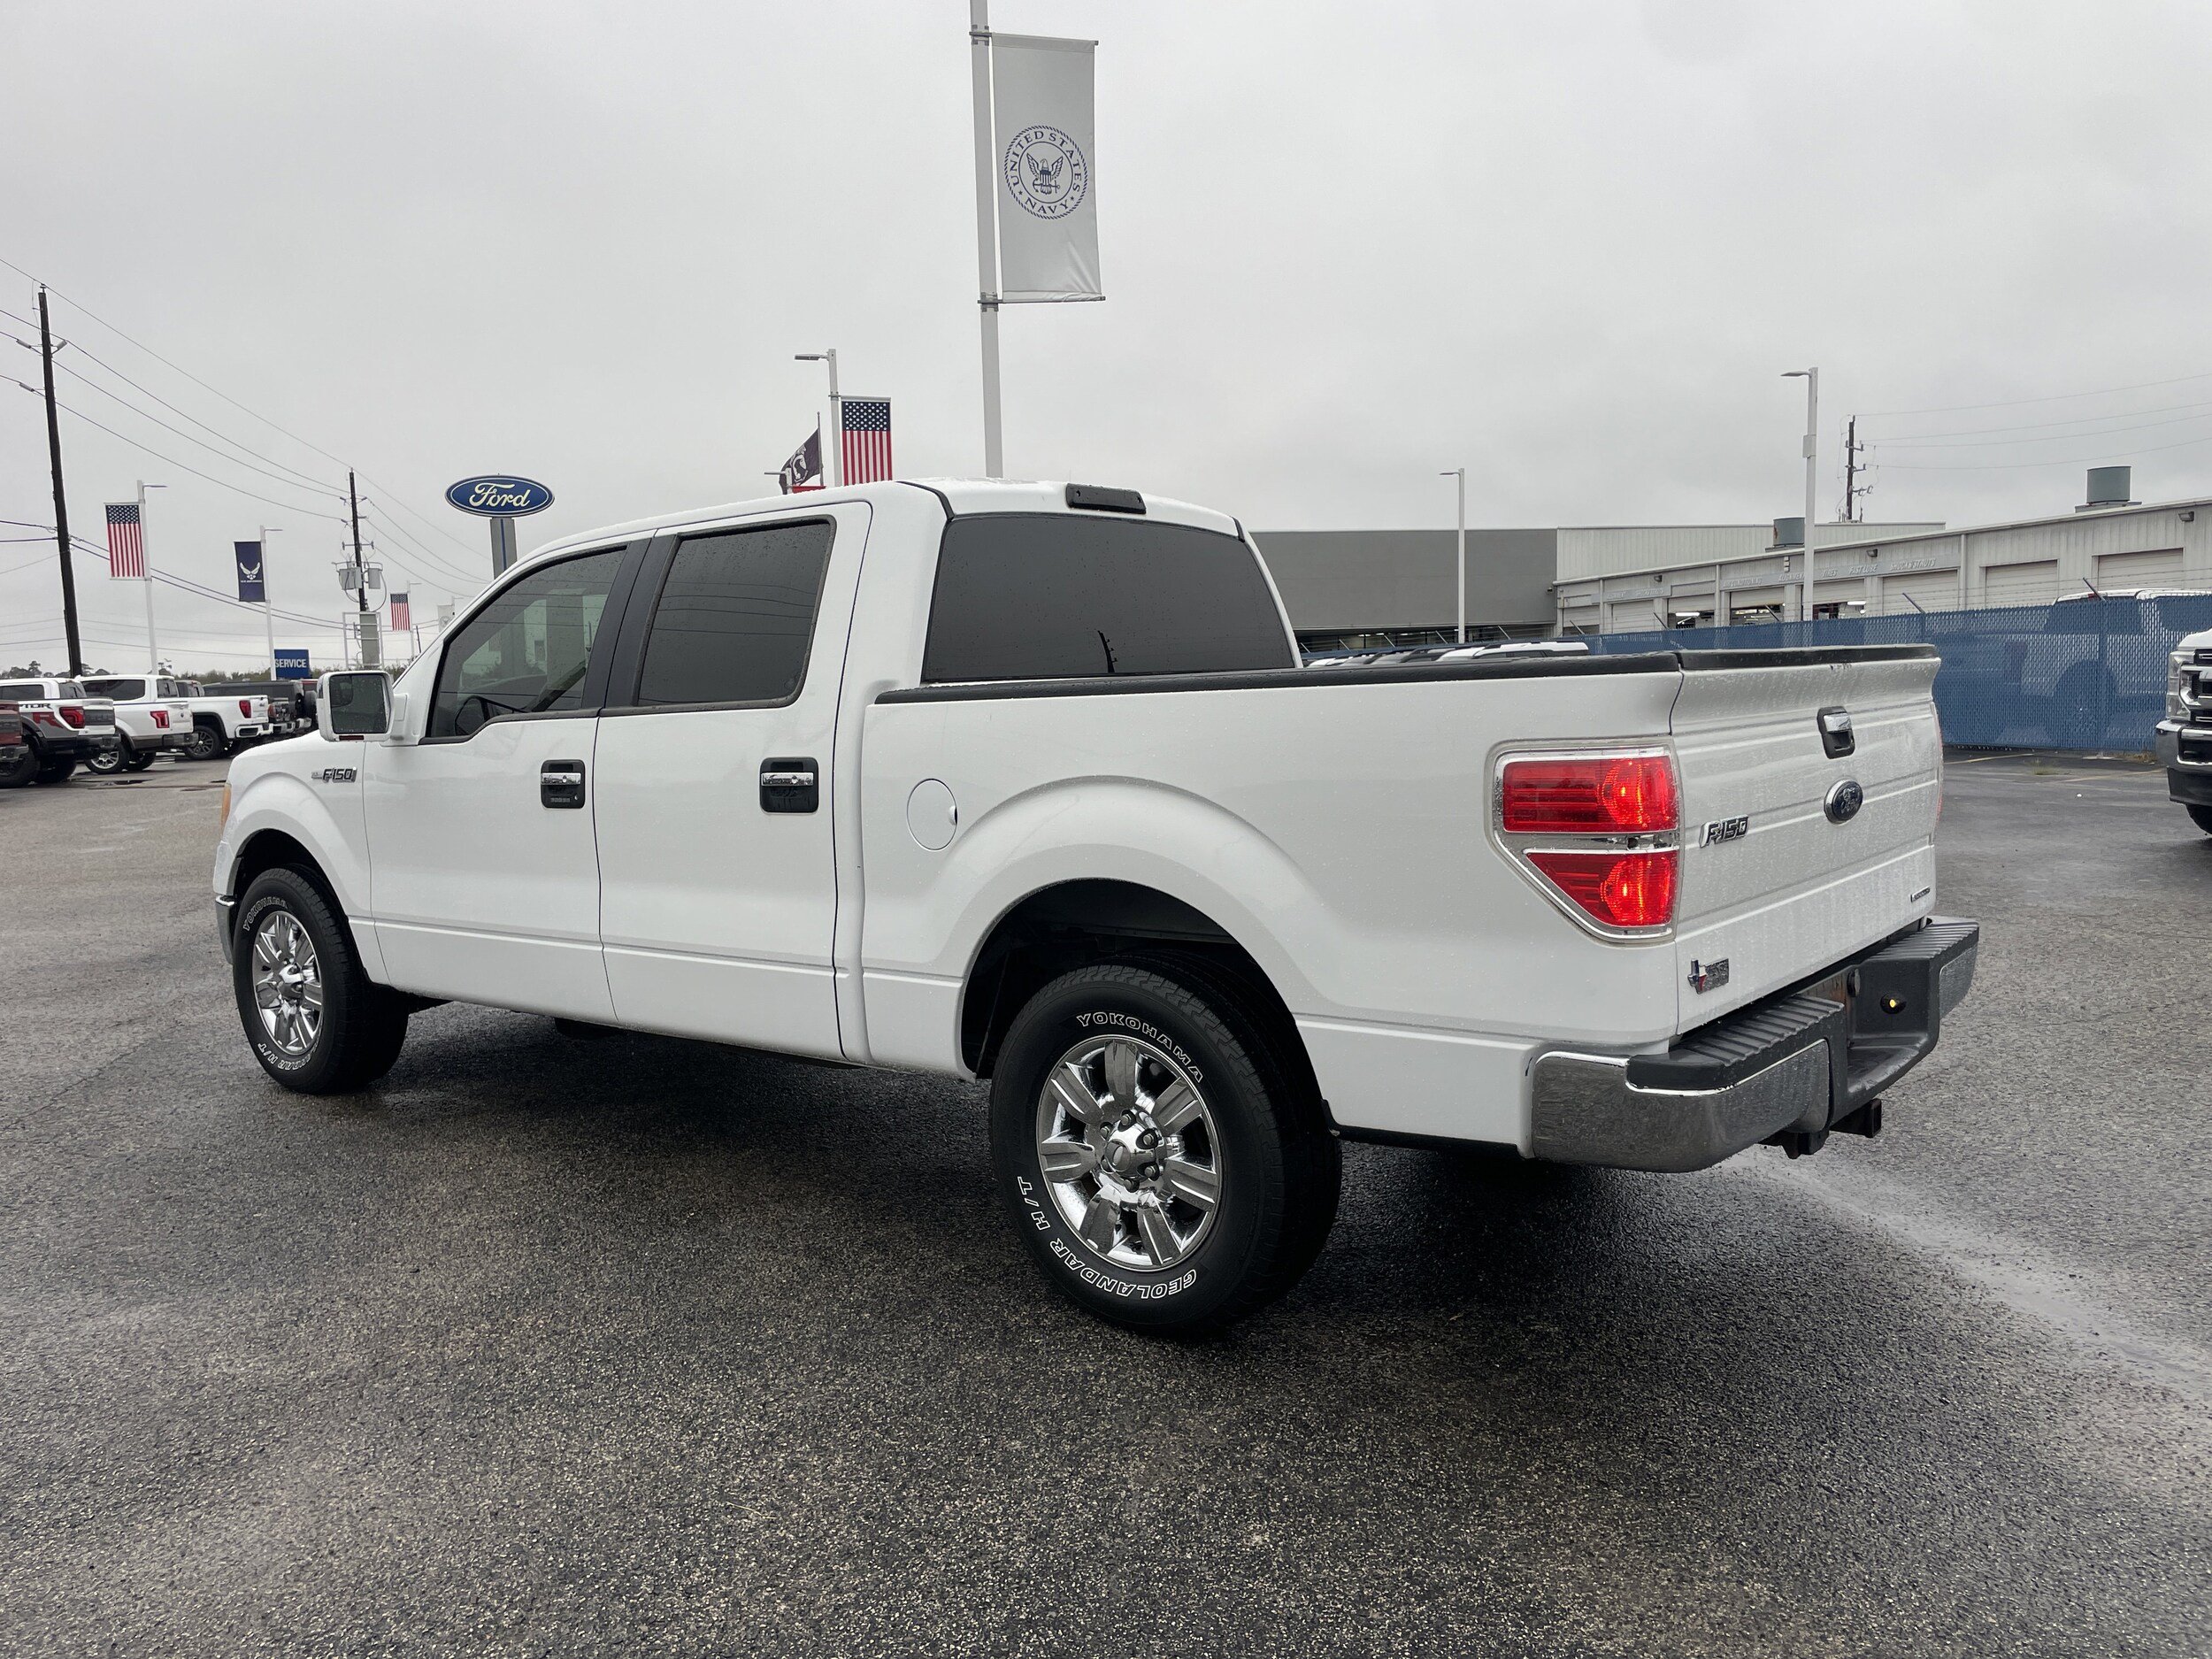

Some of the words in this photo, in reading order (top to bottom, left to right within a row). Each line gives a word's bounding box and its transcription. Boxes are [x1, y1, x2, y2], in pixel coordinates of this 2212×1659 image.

[1010, 130, 1044, 188] UNITED
[1048, 133, 1081, 192] STATES
[1025, 199, 1068, 214] NAVY
[469, 482, 532, 507] Ford
[275, 658, 307, 668] SERVICE
[323, 768, 357, 782] F-150
[1699, 814, 1749, 849] F-150
[1076, 1011, 1204, 1083] YOKOHAMA
[1017, 1176, 1051, 1231] H/T
[1049, 1237, 1197, 1300] GEOLANDAR
